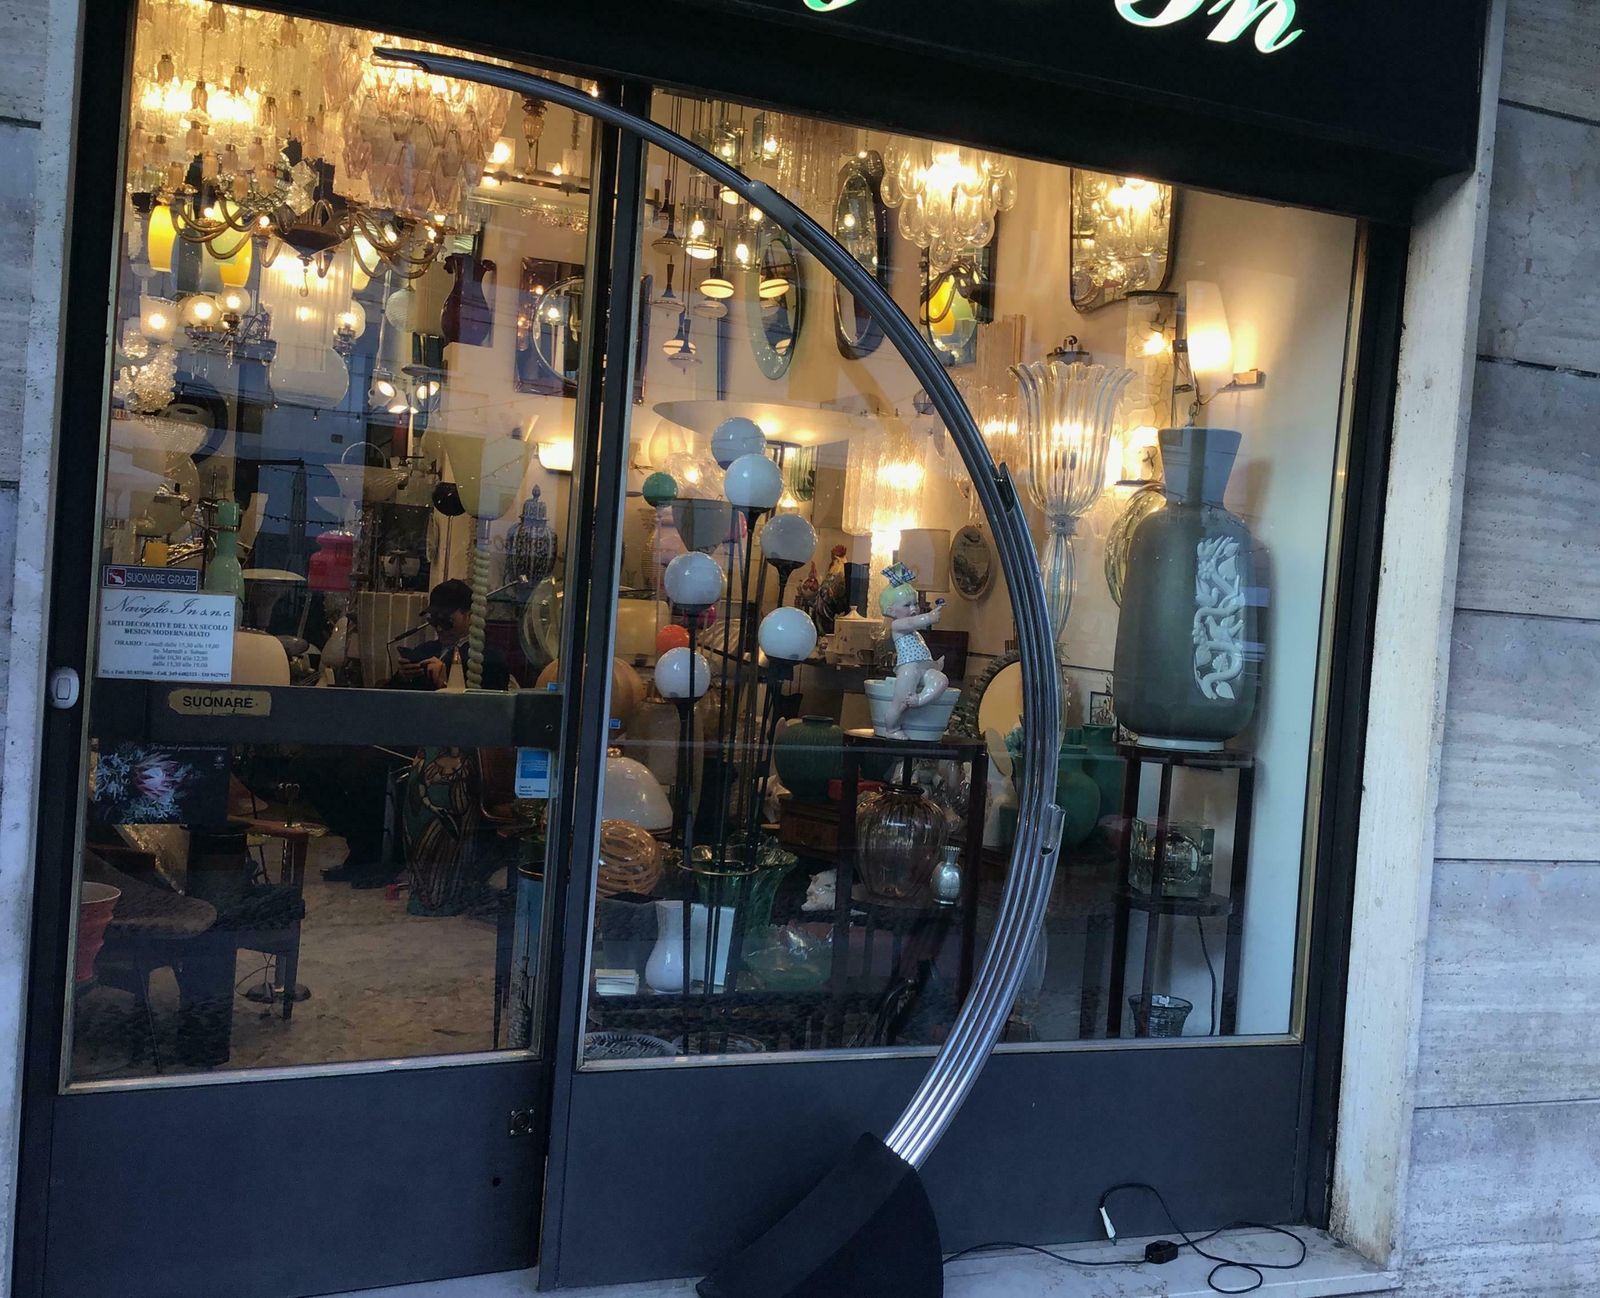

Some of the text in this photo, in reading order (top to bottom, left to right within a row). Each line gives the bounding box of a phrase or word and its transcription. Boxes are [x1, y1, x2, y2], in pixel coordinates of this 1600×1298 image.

[126, 572, 196, 586] SUONARE GRAZIE
[104, 595, 170, 618] Naviglio
[125, 620, 170, 629] DECORATIVE
[152, 629, 210, 637] MODERNARIATO
[183, 695, 254, 708] SUONARE
